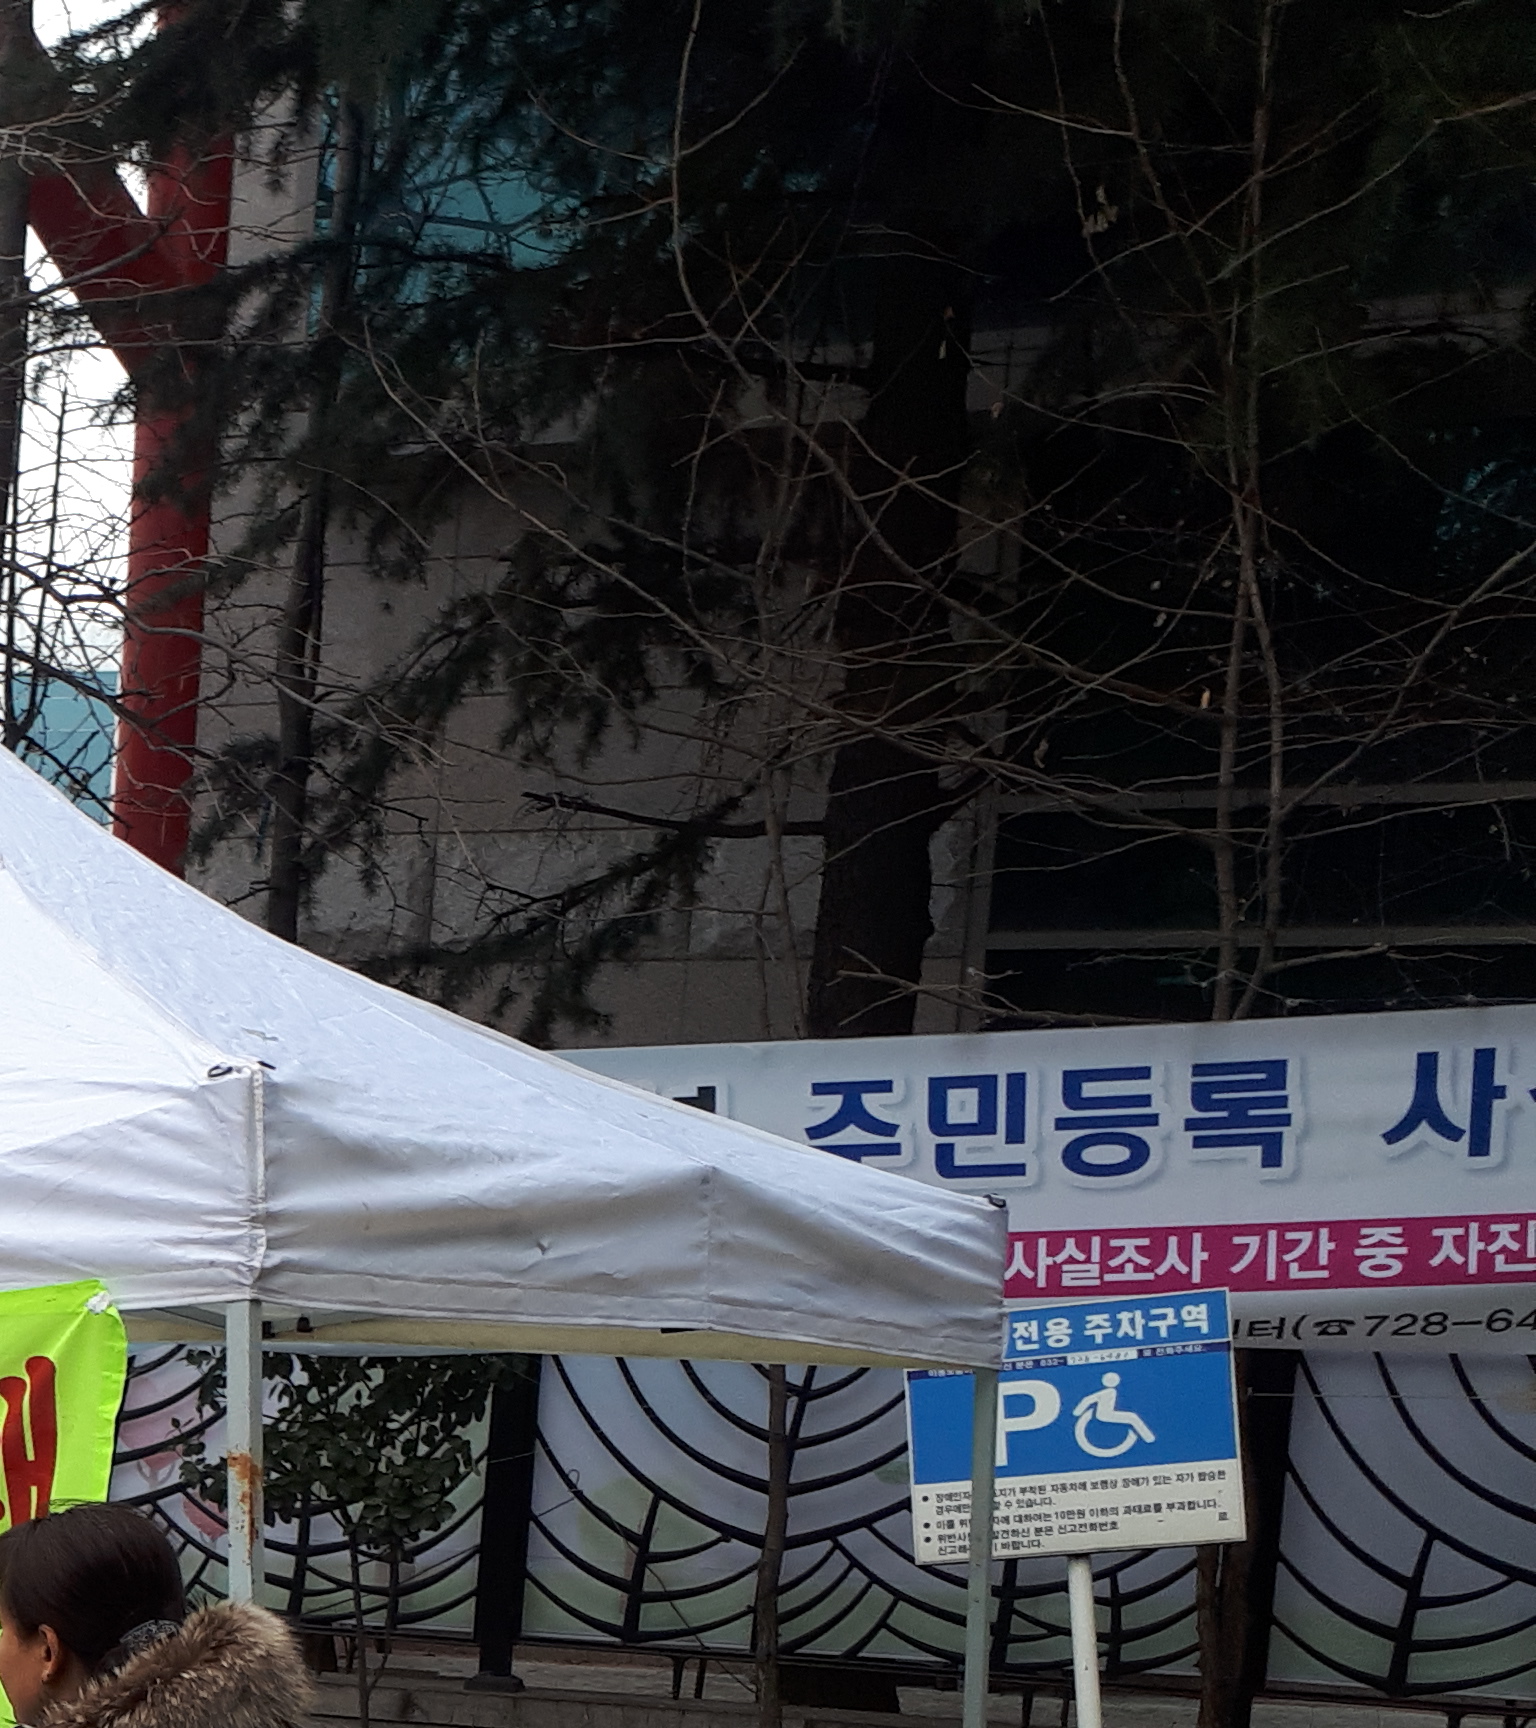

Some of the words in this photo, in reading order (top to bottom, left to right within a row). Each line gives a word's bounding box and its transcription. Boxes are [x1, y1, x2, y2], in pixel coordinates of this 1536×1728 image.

[805, 1059, 1292, 1179] 주민등록
[1380, 1047, 1536, 1158] 사
[1004, 1232, 1209, 1289] 사실조사
[1230, 1228, 1336, 1282] 기간
[1353, 1226, 1409, 1279] 중
[1012, 1317, 1073, 1351] 전용
[1084, 1303, 1209, 1345] 주차구역
